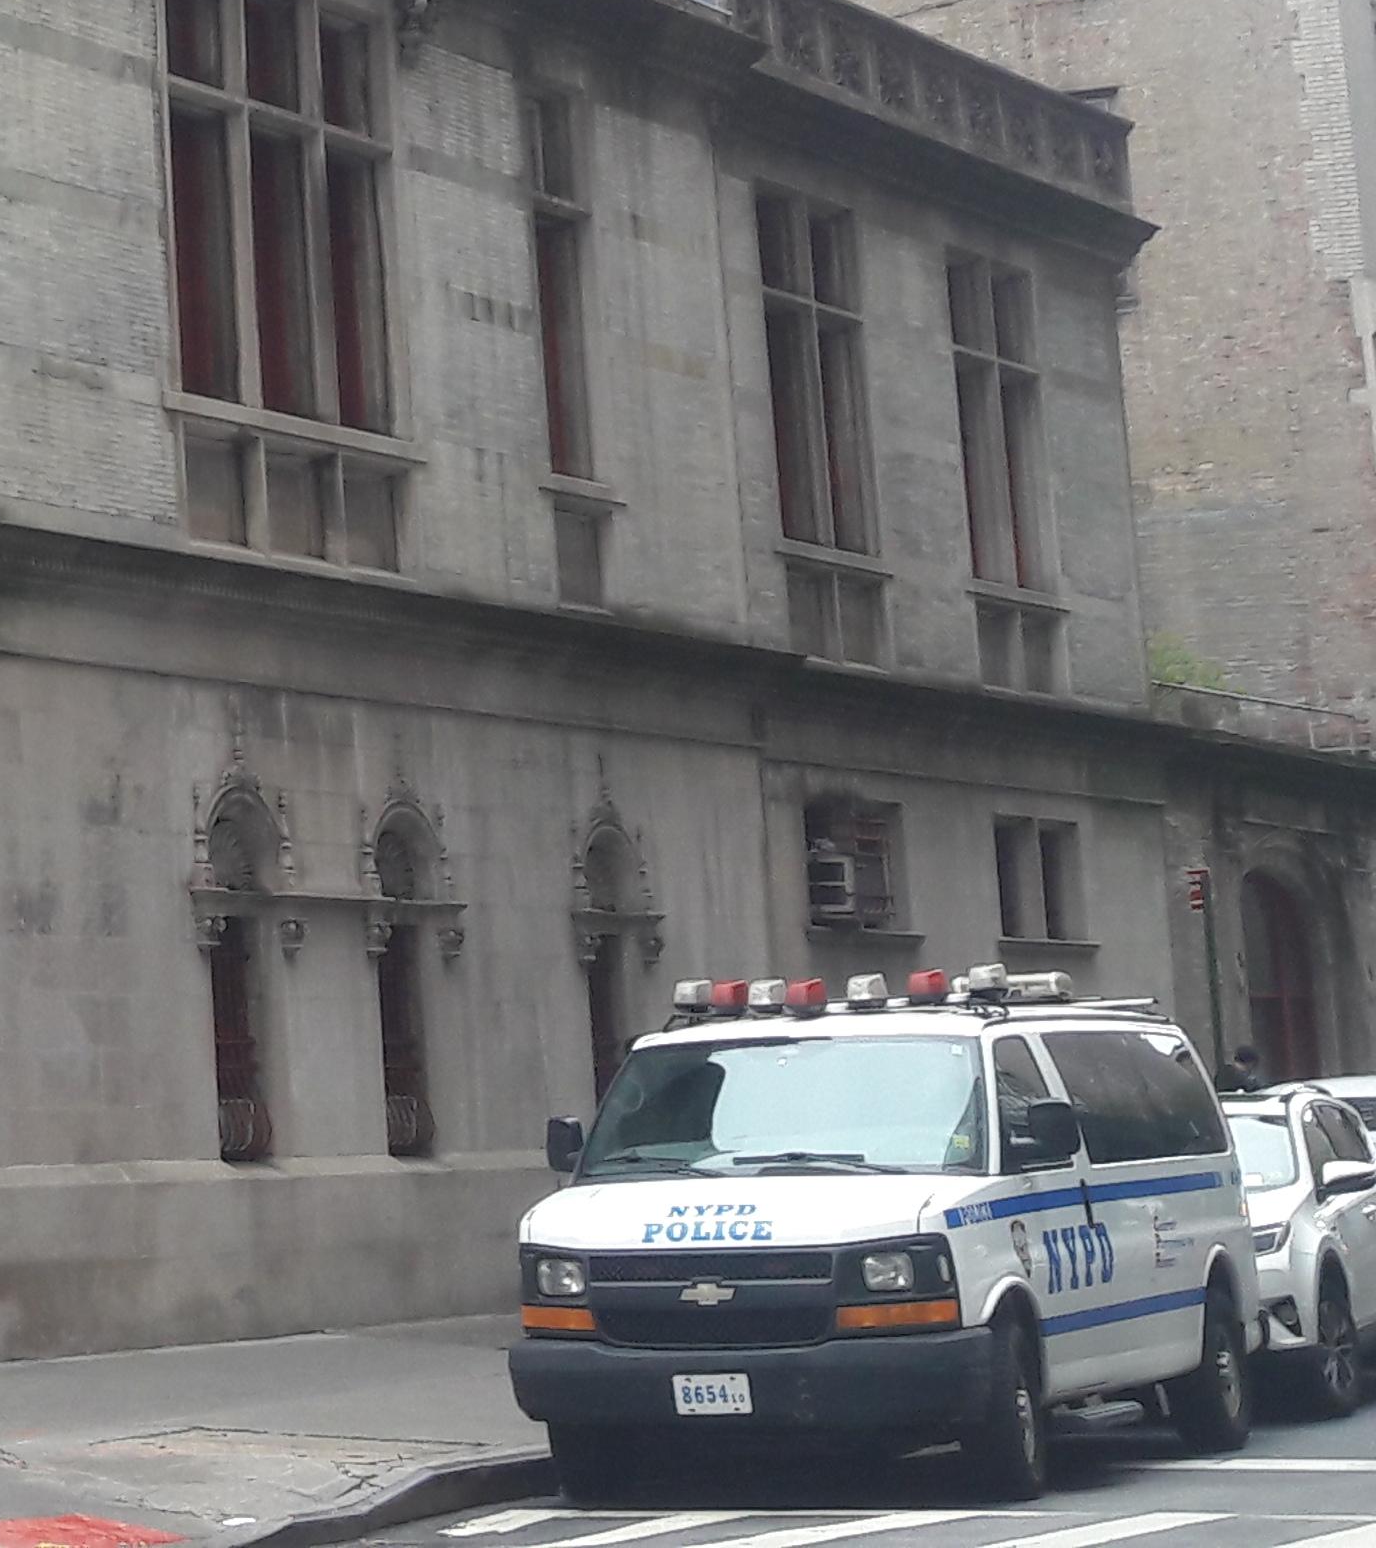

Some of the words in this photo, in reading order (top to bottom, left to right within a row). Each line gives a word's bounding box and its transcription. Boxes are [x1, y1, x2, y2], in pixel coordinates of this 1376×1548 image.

[667, 1204, 757, 1217] NYPD
[642, 1220, 773, 1244] POLICE
[1043, 1221, 1114, 1295] NYPD
[681, 1383, 729, 1404] 8654
